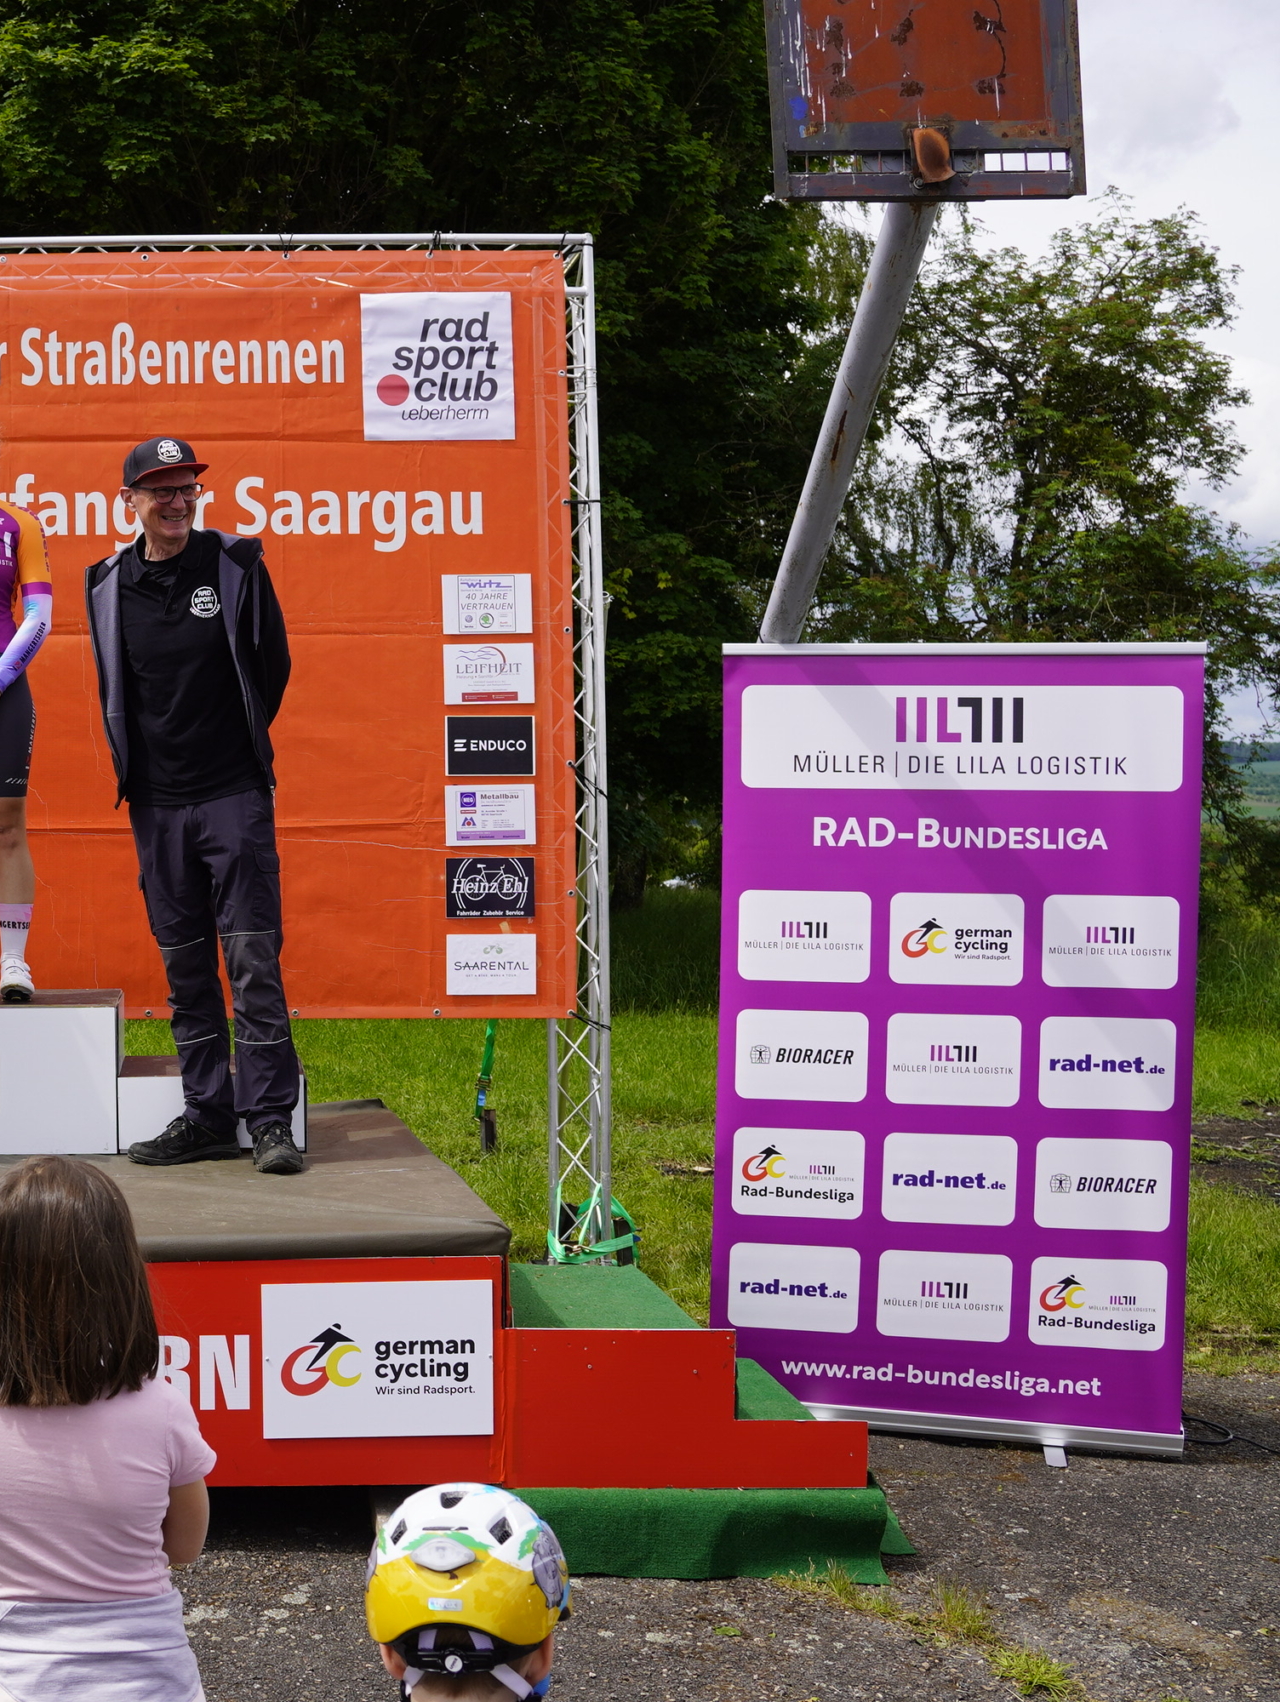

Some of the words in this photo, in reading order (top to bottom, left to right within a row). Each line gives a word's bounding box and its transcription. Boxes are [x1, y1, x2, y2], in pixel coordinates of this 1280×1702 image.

[421, 312, 489, 342] rad
[21, 322, 344, 386] Straßenrennen
[393, 341, 498, 378] sport
[414, 370, 498, 401] club
[401, 405, 489, 420] ueberherrn
[235, 476, 483, 553] Saargau
[456, 663, 522, 674] LEIFHEIT
[470, 739, 526, 751] ENDUCO
[794, 750, 885, 774] MÜLLER
[908, 756, 945, 774] DIE
[957, 756, 1005, 775] LILA
[1018, 756, 1128, 776] LOGISTIK
[451, 877, 498, 894] Heinz
[502, 877, 529, 893] Ehl
[955, 928, 1012, 940] german
[745, 940, 778, 949] MÜLLER
[824, 943, 864, 951] LOGISTIK
[955, 939, 1008, 953] cycling
[1049, 946, 1083, 954] MÜLLER
[1109, 948, 1127, 956] LILA
[776, 1047, 854, 1065] BIORACER
[1049, 1054, 1165, 1075] rad-net.de
[893, 1063, 927, 1072] MÜLLER
[952, 1066, 970, 1074] LILA
[974, 1067, 1013, 1075] LOGISTIK
[892, 1170, 1006, 1191] rad-net.de
[1076, 1176, 1157, 1195] BIORACER
[741, 1185, 854, 1203] Rad-Bundesliga
[739, 1279, 848, 1300] rad-net.de
[884, 1298, 918, 1307] MÜLLER
[964, 1303, 1004, 1312] LOGISTIK
[1038, 1315, 1155, 1334] Rad-Bundesliga
[375, 1339, 475, 1361] german
[375, 1358, 469, 1383] cycling
[781, 1359, 1102, 1396] www.rad-bundesliga.net
[375, 1386, 394, 1395] Wir
[398, 1386, 420, 1394] sind
[423, 1385, 475, 1396] Radsport.
